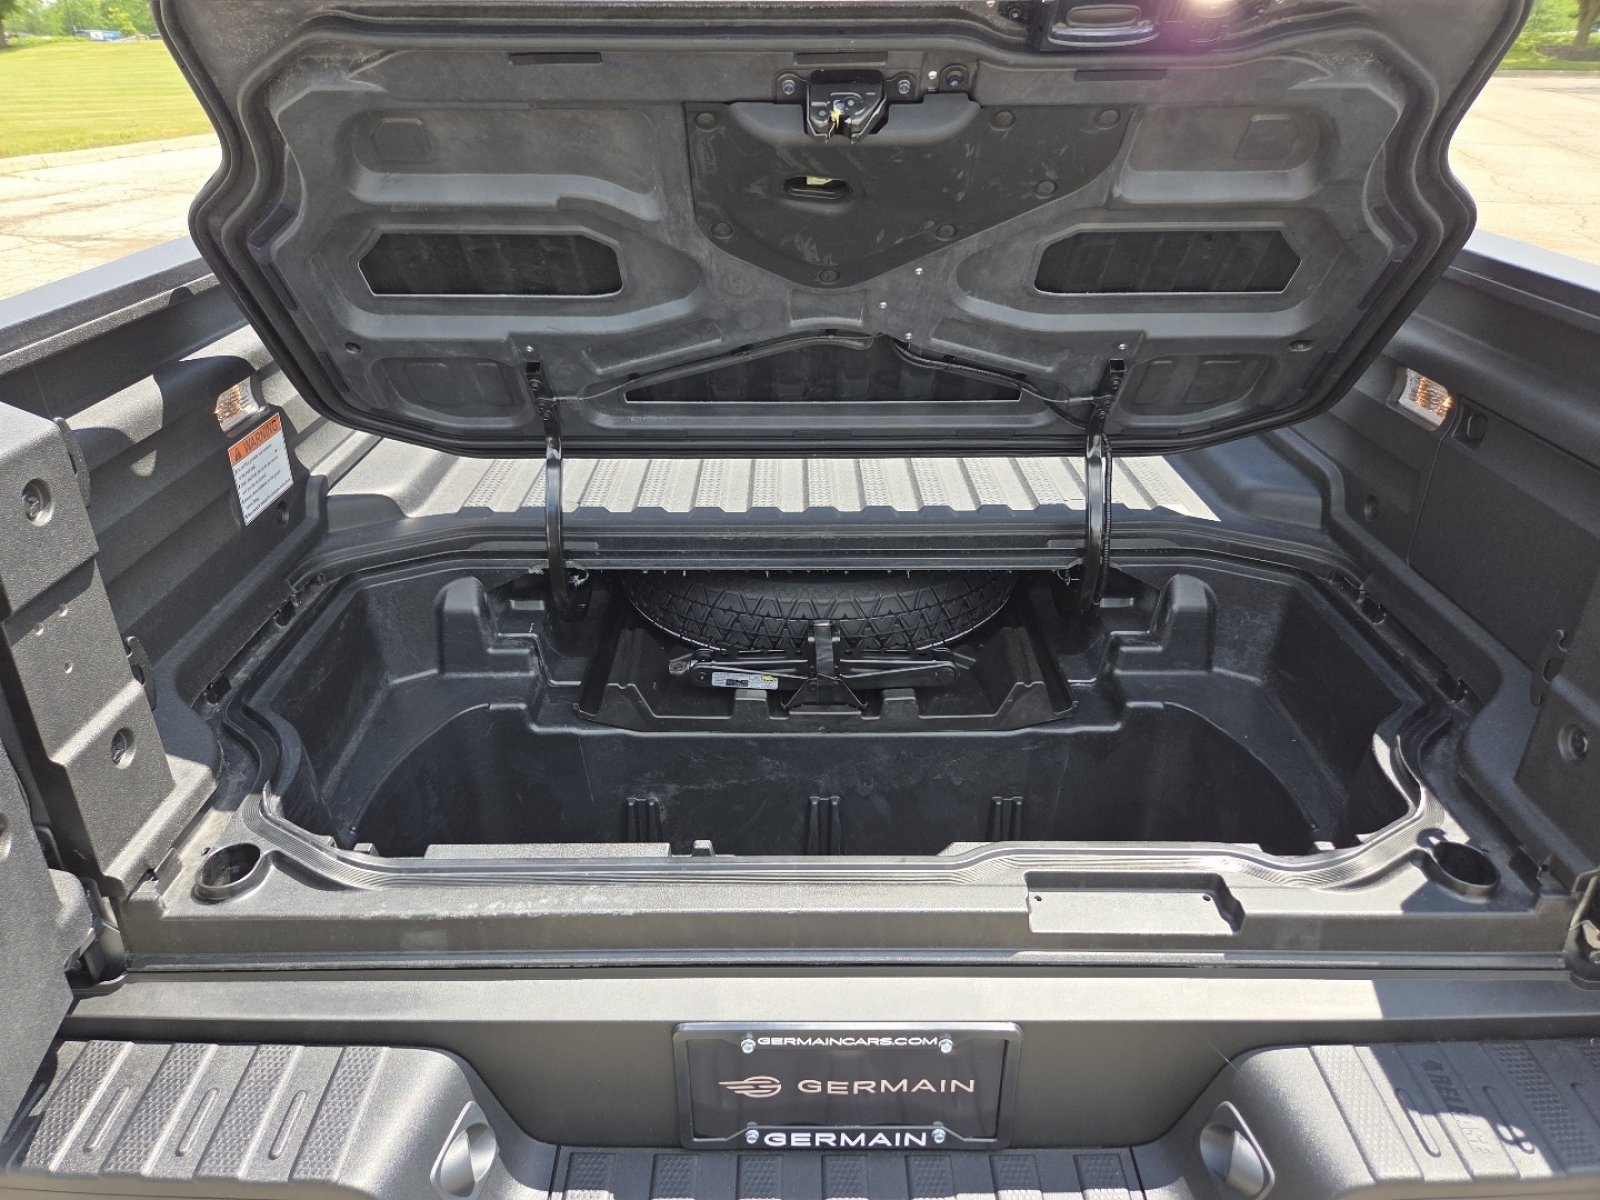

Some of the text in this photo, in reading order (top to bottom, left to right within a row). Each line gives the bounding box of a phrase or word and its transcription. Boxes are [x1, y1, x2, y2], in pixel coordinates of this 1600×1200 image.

[244, 419, 279, 452] WARNING
[757, 1037, 938, 1047] GERMAINCARS.COM
[797, 1079, 975, 1094] GERMAIN
[1430, 1073, 1495, 1155] RELEASE
[764, 1132, 927, 1147] GERMAIN
